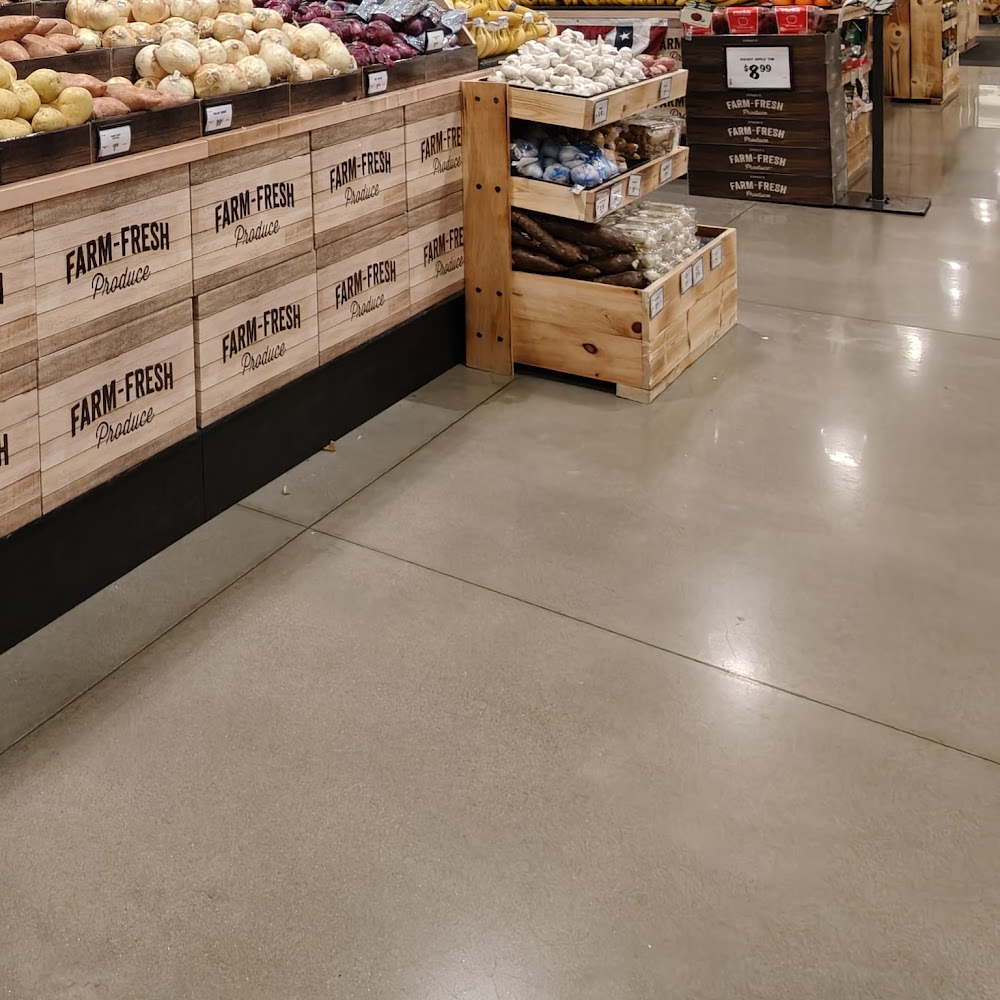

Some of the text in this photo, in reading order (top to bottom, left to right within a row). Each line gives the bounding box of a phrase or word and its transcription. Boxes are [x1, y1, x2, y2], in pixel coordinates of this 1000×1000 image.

[726, 98, 784, 112] FARM-FRESH
[727, 126, 786, 139] FARM-FRESH
[329, 151, 392, 194] FARM-FRESH
[728, 153, 787, 167] FARM-FRESH
[344, 183, 380, 208] Produce
[729, 181, 788, 195] FARM-FRESH
[215, 182, 295, 234] FARM-FRESH
[234, 219, 281, 249] Produce
[65, 222, 170, 285] FARM-FRESH
[91, 264, 151, 300] Produce
[335, 260, 397, 310] FARM-FRESH
[350, 293, 386, 322] Produce
[222, 304, 301, 364] FARM-FRESH
[241, 342, 287, 376] Produce
[70, 362, 174, 438] FARM-FRESH
[95, 406, 156, 449] Produce
